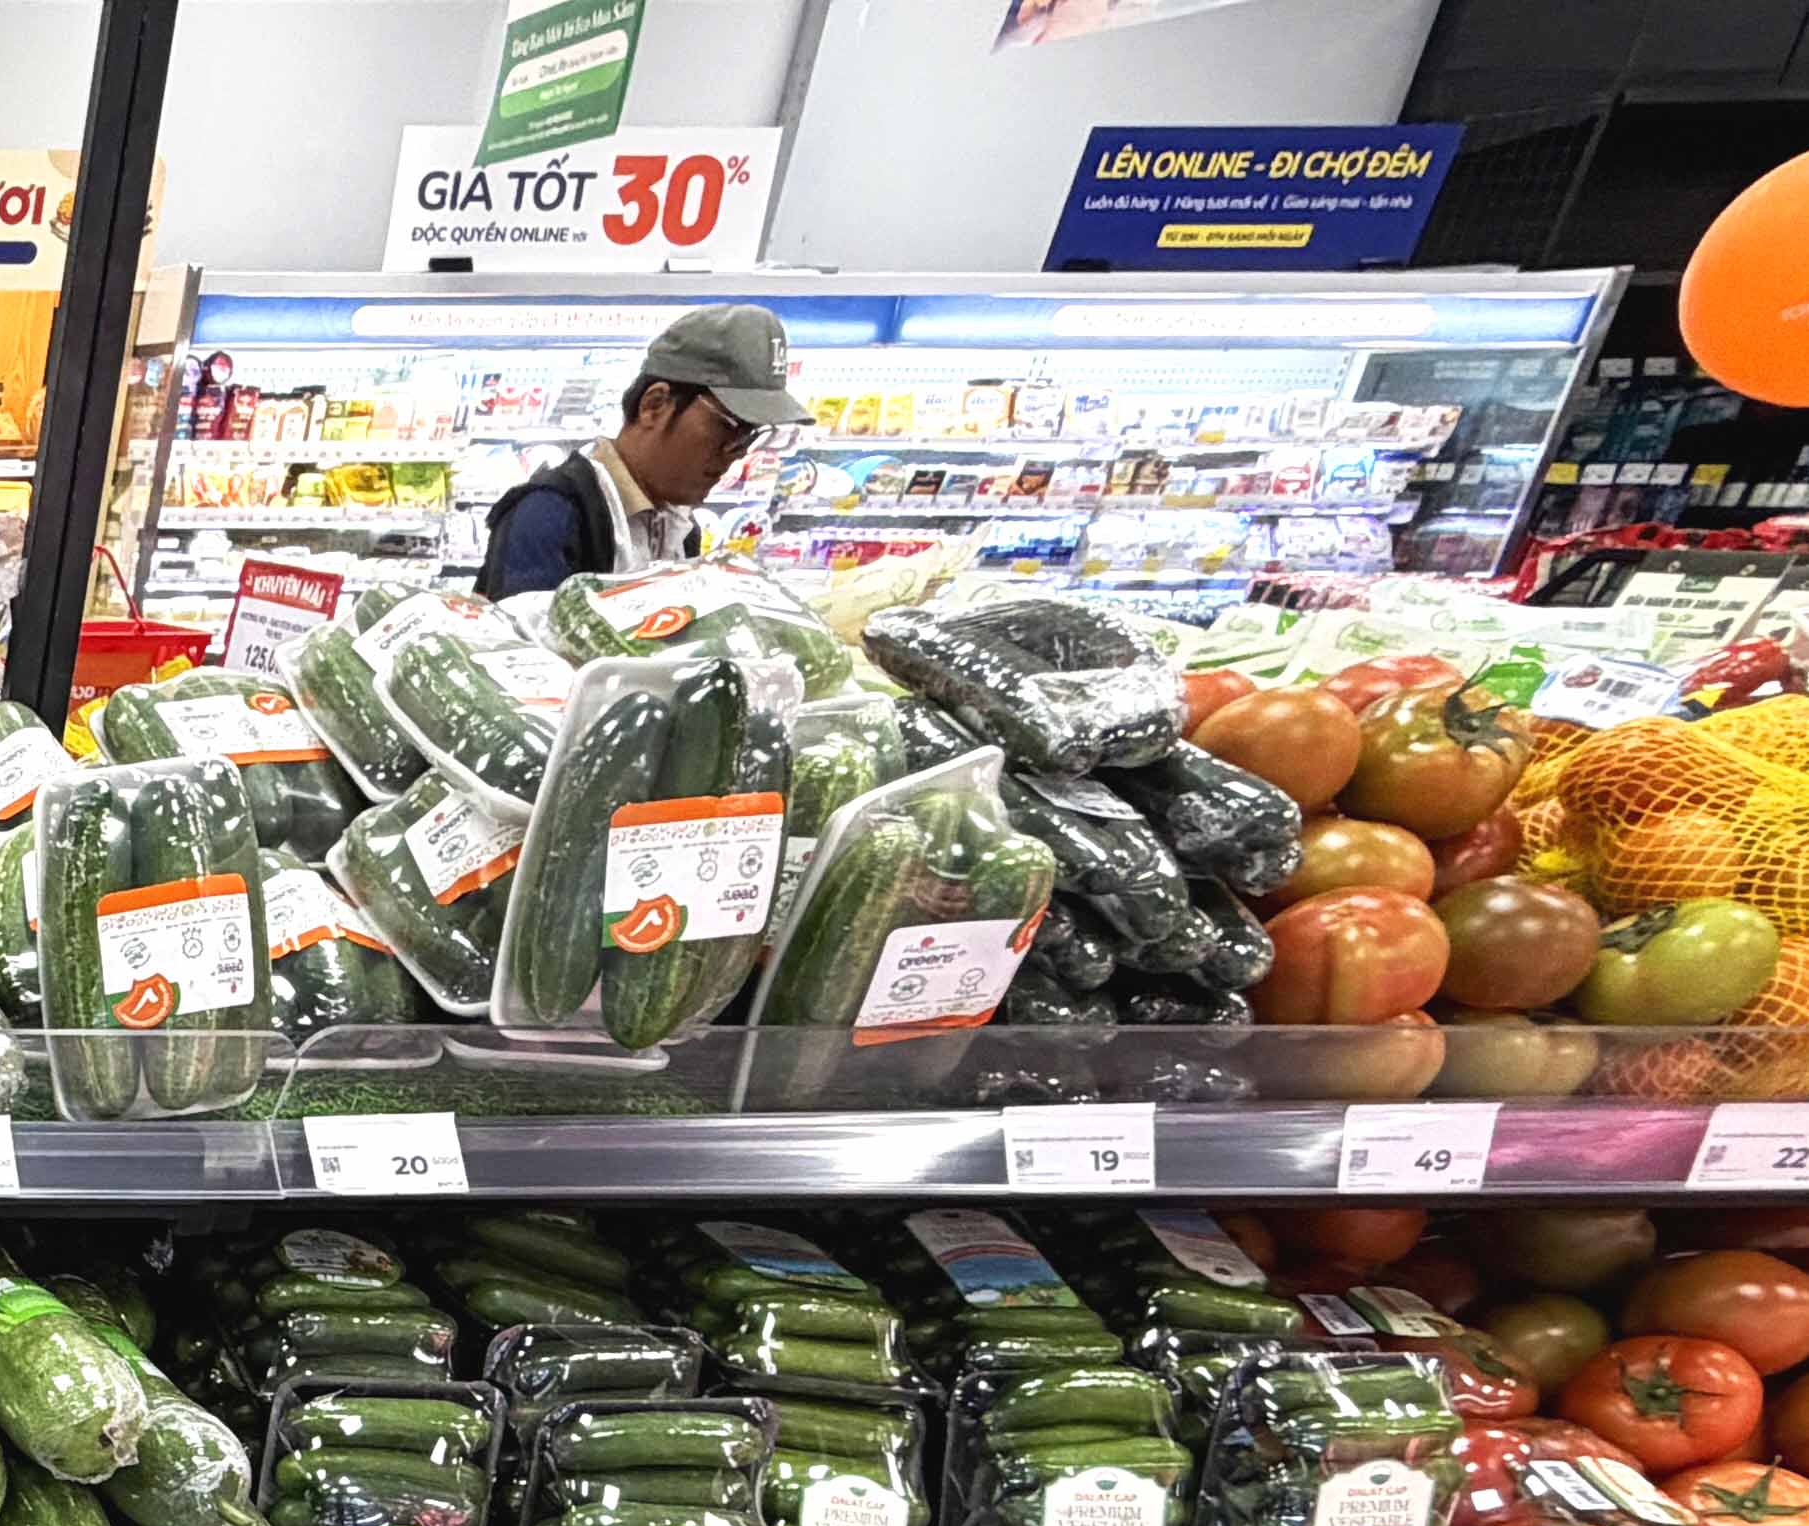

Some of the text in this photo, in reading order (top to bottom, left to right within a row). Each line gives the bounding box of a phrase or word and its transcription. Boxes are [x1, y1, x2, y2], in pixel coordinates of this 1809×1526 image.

[1095, 142, 1152, 179] LÊN
[1152, 150, 1254, 179] ONLINE
[1268, 150, 1302, 179] ĐI
[1303, 147, 1370, 186] CHỢ
[1365, 142, 1432, 179] ĐÊM
[508, 154, 598, 212] TỐT
[602, 154, 752, 246] 30%
[411, 221, 568, 246] ĐỘC QUYỀN ONLINE
[391, 1155, 429, 1176] 20
[1089, 1149, 1120, 1172] 19
[1413, 1149, 1453, 1172] 49
